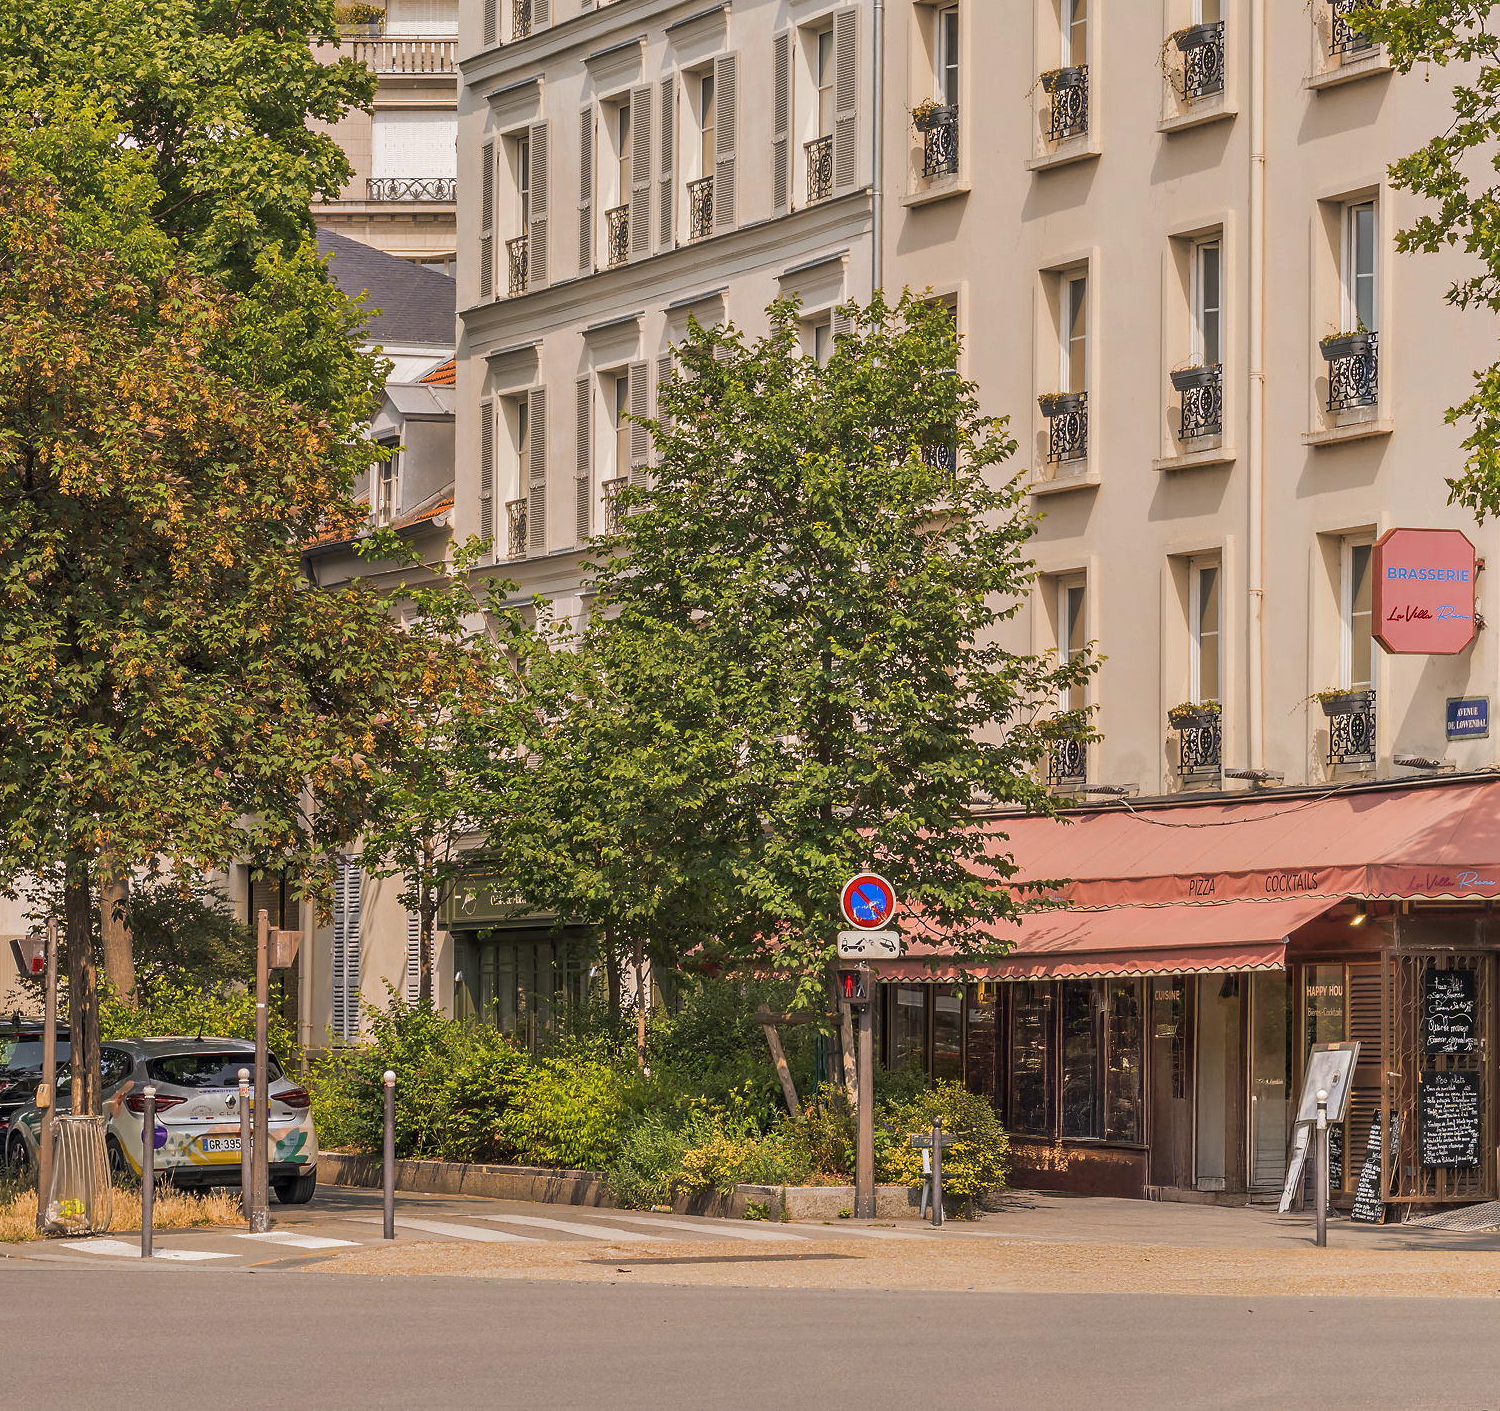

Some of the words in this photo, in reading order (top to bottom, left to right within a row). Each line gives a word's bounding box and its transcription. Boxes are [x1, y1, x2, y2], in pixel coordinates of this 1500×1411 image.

[1387, 567, 1469, 582] BRASSERIE
[1386, 606, 1404, 621] La
[1405, 605, 1432, 622] Villa
[1456, 706, 1478, 717] AVENUE
[1447, 721, 1456, 730] DE
[1456, 718, 1487, 729] LOWENDAL
[1188, 879, 1216, 896] PIZZA
[1265, 873, 1319, 893] COCKTAILS
[1406, 875, 1423, 890] La
[1426, 873, 1455, 890] Villa
[1456, 871, 1496, 890] Reine
[1154, 990, 1180, 1001] CUISINE
[1306, 985, 1327, 996] HAPPY
[1328, 985, 1343, 996] HOU
